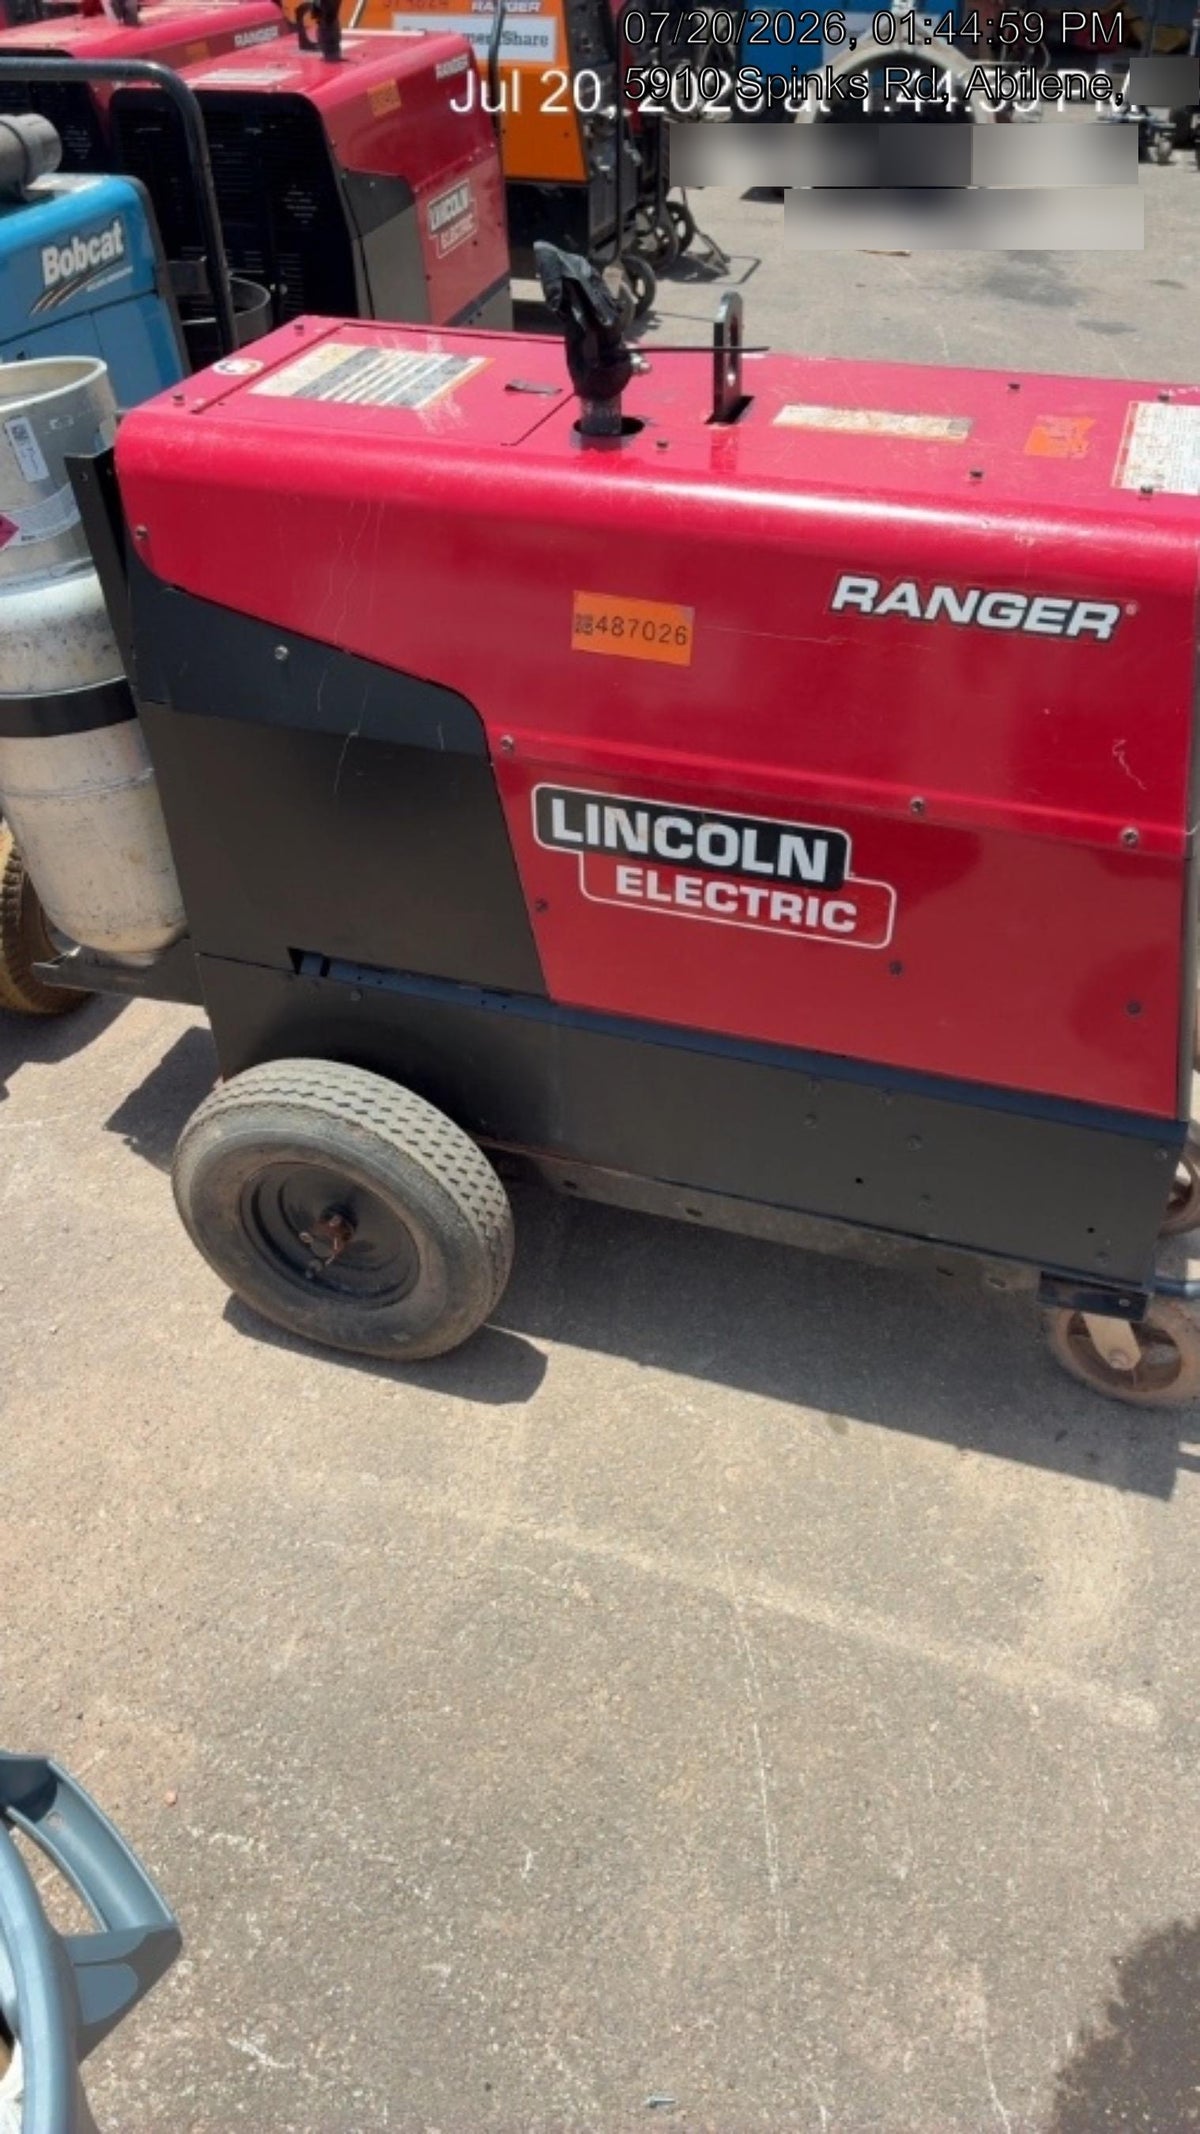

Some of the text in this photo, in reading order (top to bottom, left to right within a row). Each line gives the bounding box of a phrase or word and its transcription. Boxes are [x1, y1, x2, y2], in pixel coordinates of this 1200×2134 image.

[471, 0, 543, 12] RAGER
[42, 219, 124, 287] Bobcat
[594, 615, 688, 647] 487026
[830, 575, 1121, 640] RANGER
[551, 798, 829, 884] LINCOLN
[615, 865, 857, 934] ELECTRIC
